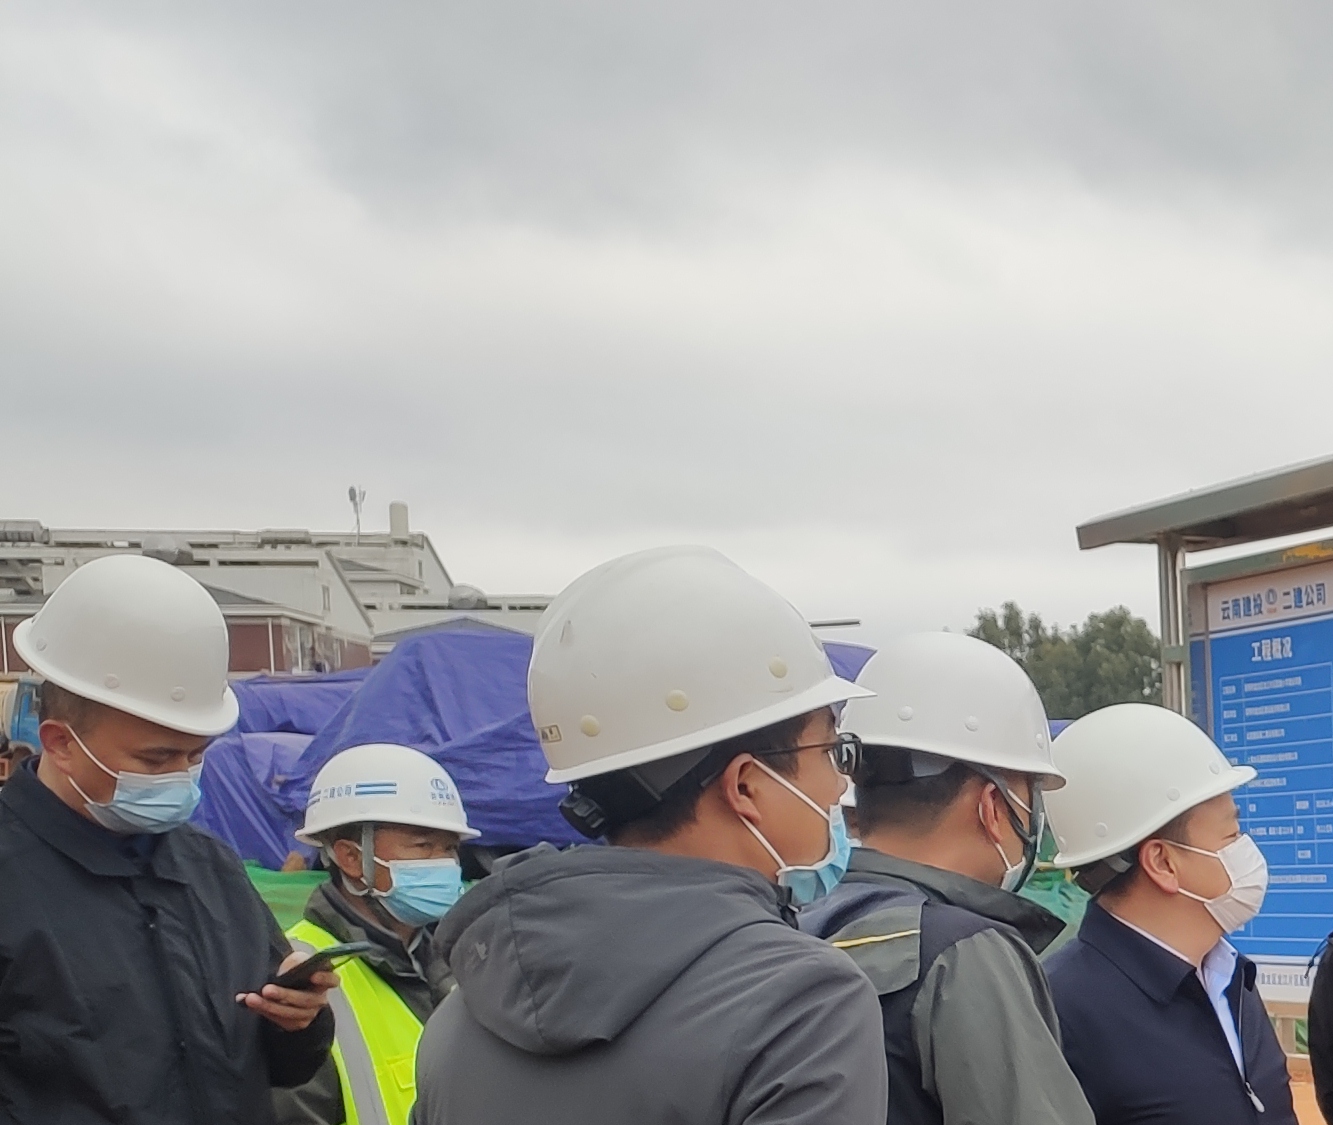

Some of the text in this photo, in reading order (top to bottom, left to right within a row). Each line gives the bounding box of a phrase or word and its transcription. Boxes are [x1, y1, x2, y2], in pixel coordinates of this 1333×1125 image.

[1220, 582, 1326, 621] 云南建投 二建公司
[1251, 636, 1293, 662] 工程概况
